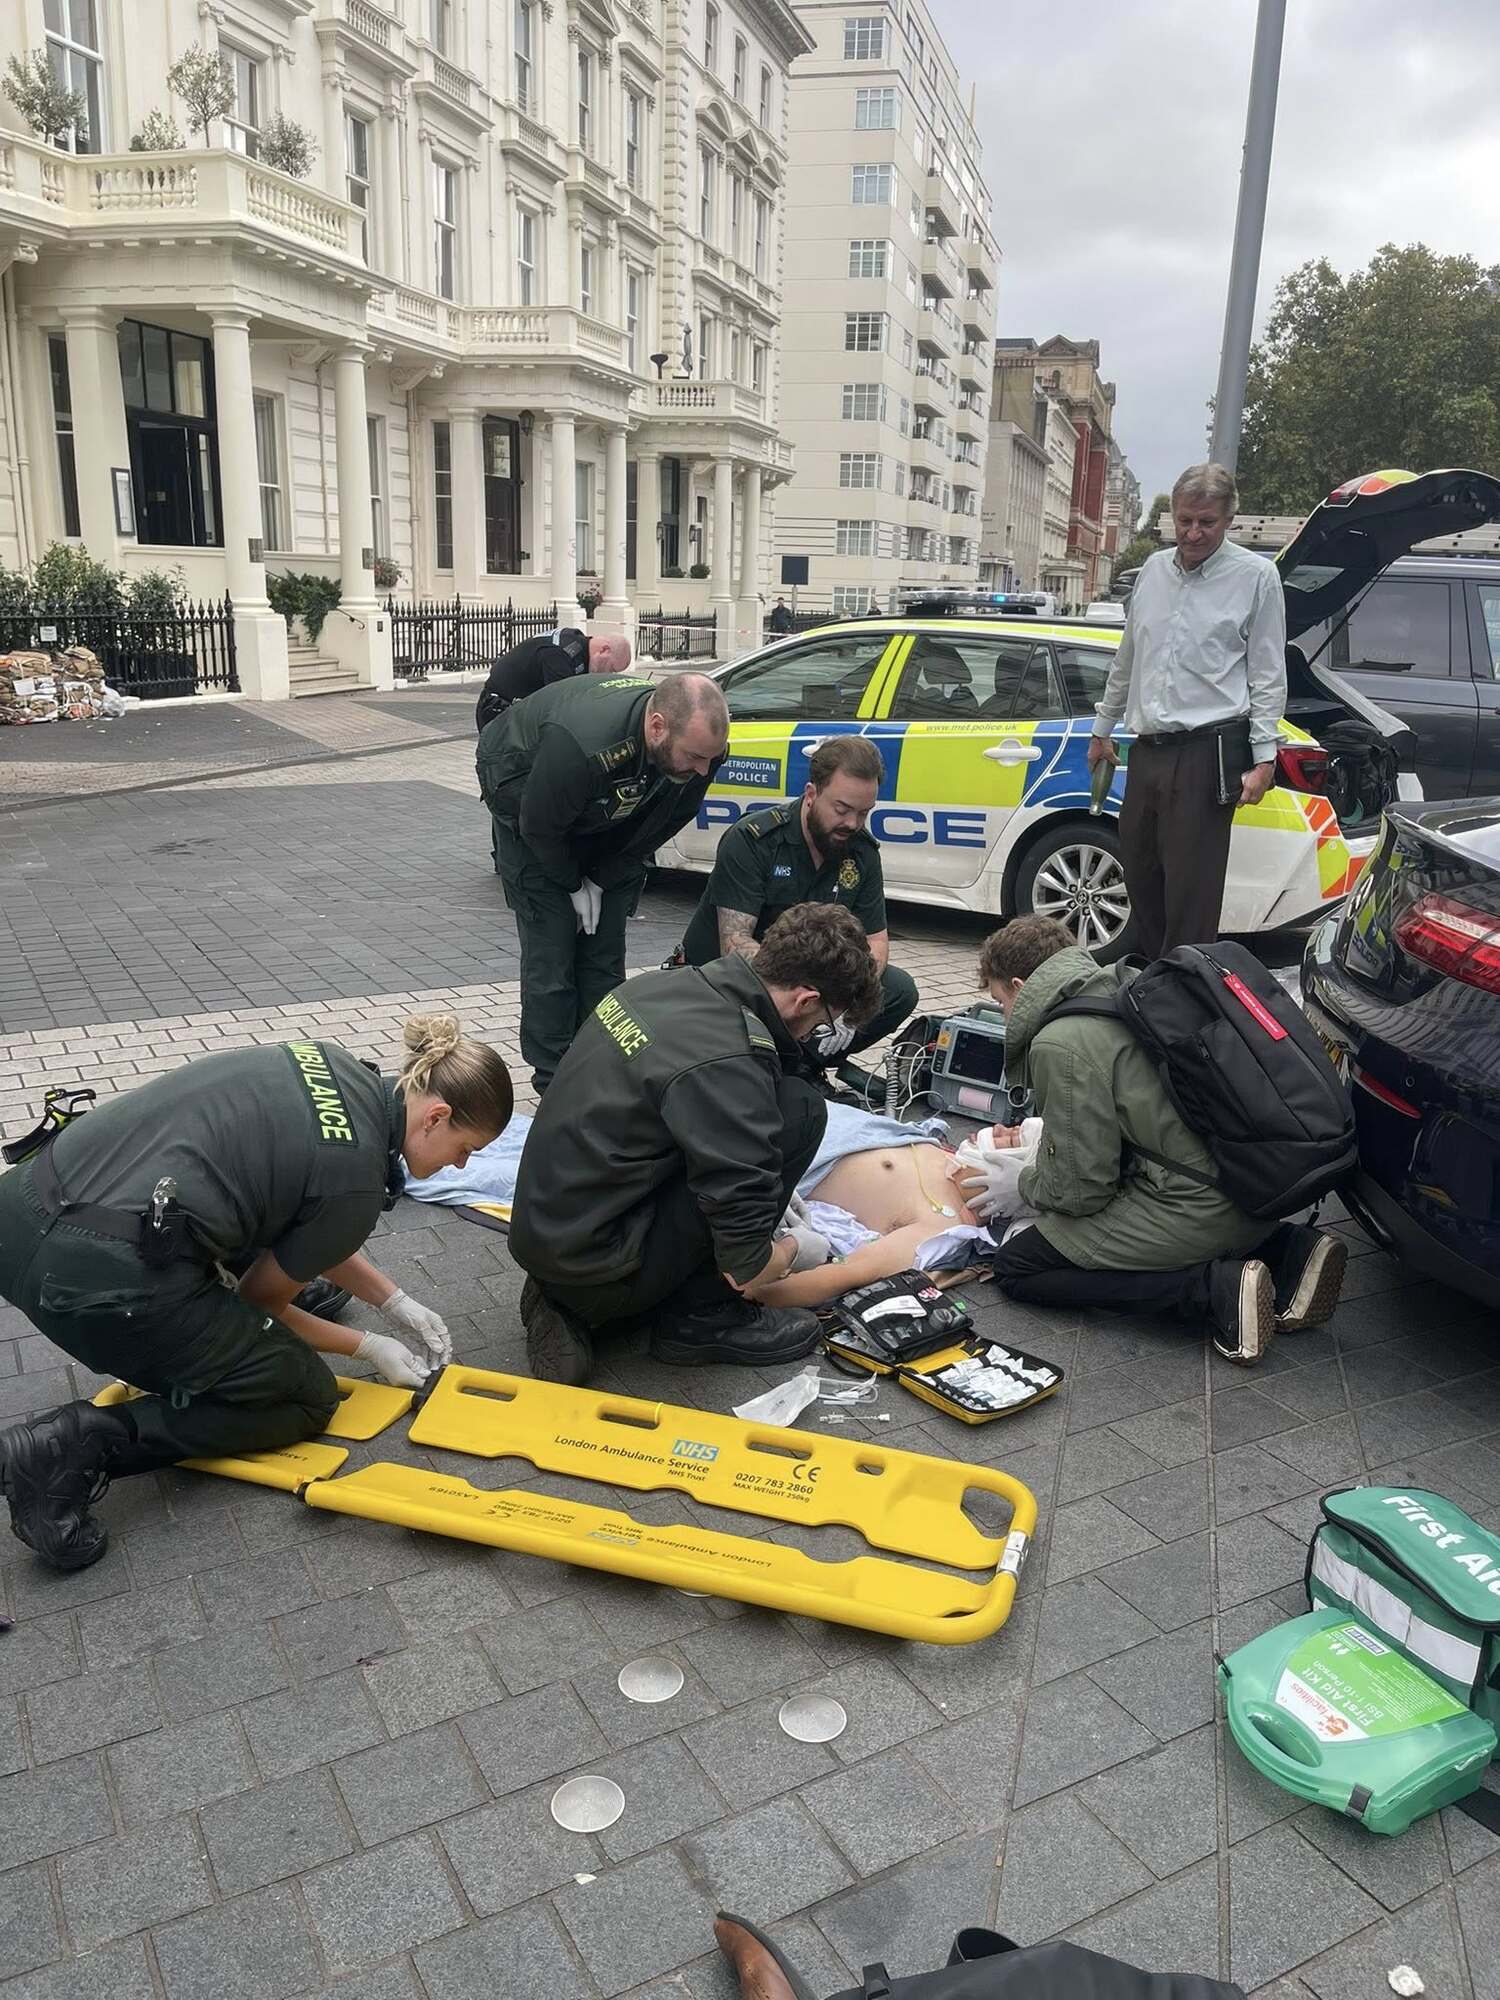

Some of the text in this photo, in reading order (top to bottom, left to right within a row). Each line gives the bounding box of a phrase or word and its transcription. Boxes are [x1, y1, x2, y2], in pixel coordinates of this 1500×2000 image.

[927, 723, 1017, 733] www.met.police.uk
[728, 771, 768, 783] POLICE
[697, 800, 986, 848] PCE
[774, 865, 791, 876] NHS
[595, 994, 648, 1056] MBULANCE
[287, 1041, 353, 1141] MBULANCE
[554, 1434, 710, 1474] London Ambulance Service
[673, 1440, 718, 1460] NHS
[668, 1469, 706, 1482] NHS Trust
[733, 1481, 752, 1491] MAX
[753, 1485, 785, 1498] WEIGHT
[735, 1472, 814, 1495] 0207 783 2860
[792, 1463, 821, 1483] CE
[1381, 1495, 1467, 1550] First
[598, 1526, 772, 1568] London Ambulance Service
[1290, 1682, 1330, 1716] facilities
[1302, 1667, 1374, 1727] First Aid Kit
[1313, 1659, 1385, 1720] BSI 1-10 Person
